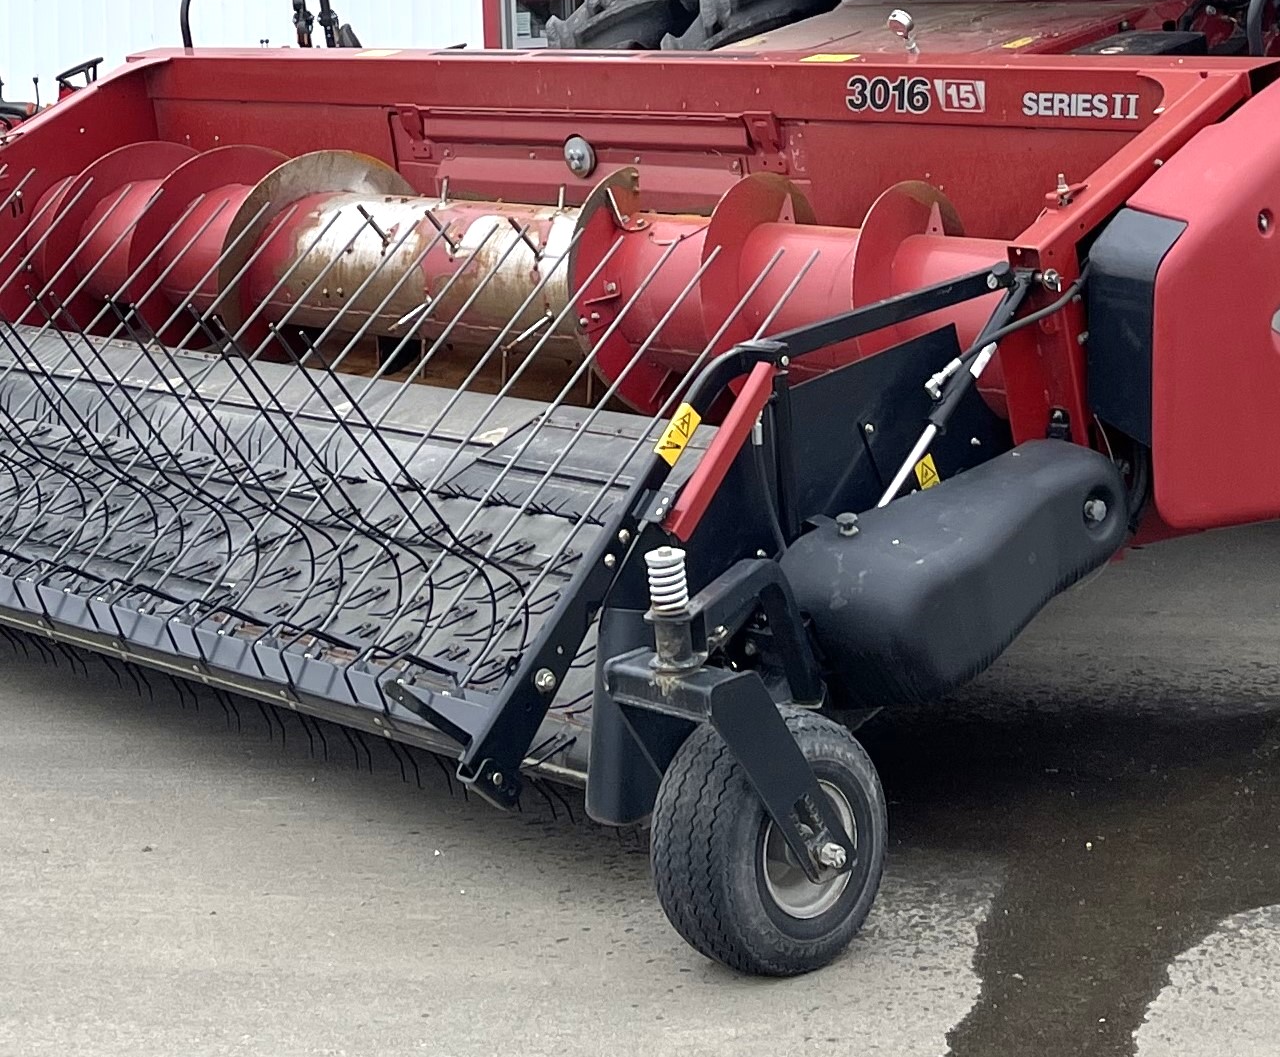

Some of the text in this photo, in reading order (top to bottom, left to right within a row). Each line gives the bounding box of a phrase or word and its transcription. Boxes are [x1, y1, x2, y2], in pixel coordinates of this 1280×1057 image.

[846, 74, 976, 114] 3016 15
[1022, 92, 1139, 119] SERIES II
